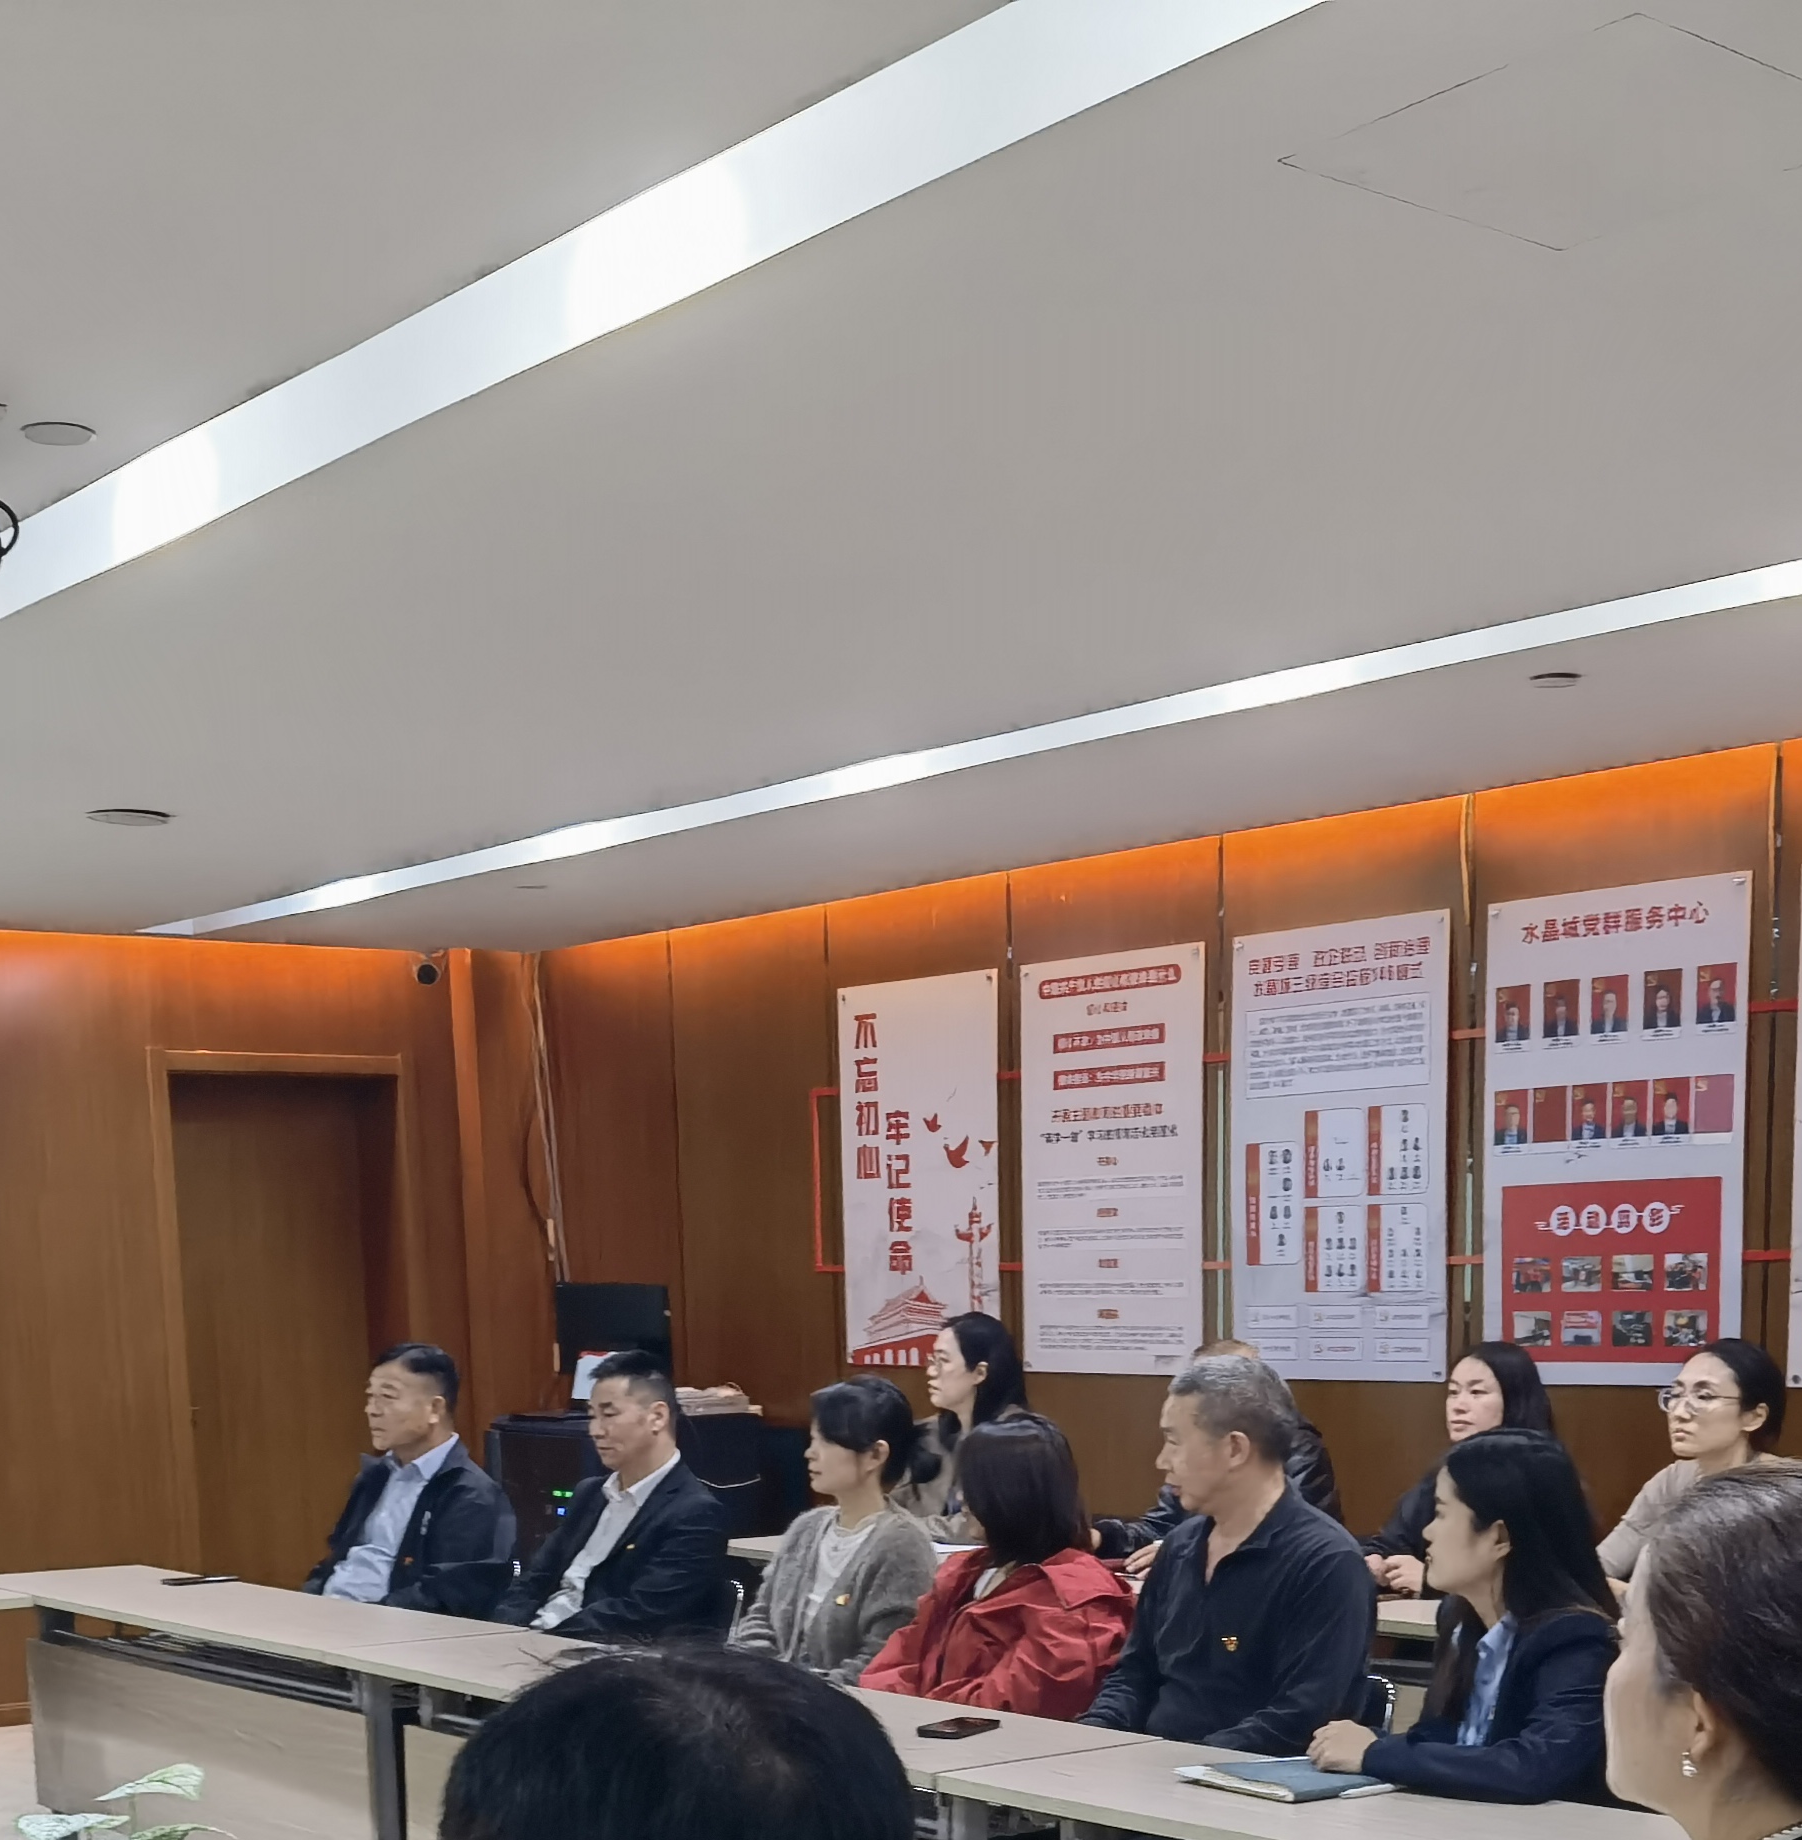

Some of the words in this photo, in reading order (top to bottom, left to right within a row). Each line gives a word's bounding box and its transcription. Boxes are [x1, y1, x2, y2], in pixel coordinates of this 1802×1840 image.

[1521, 901, 1710, 945] 水晶城党群服务中心
[854, 1013, 881, 1180] 不忘初心
[885, 1110, 913, 1275] 牢记使命
